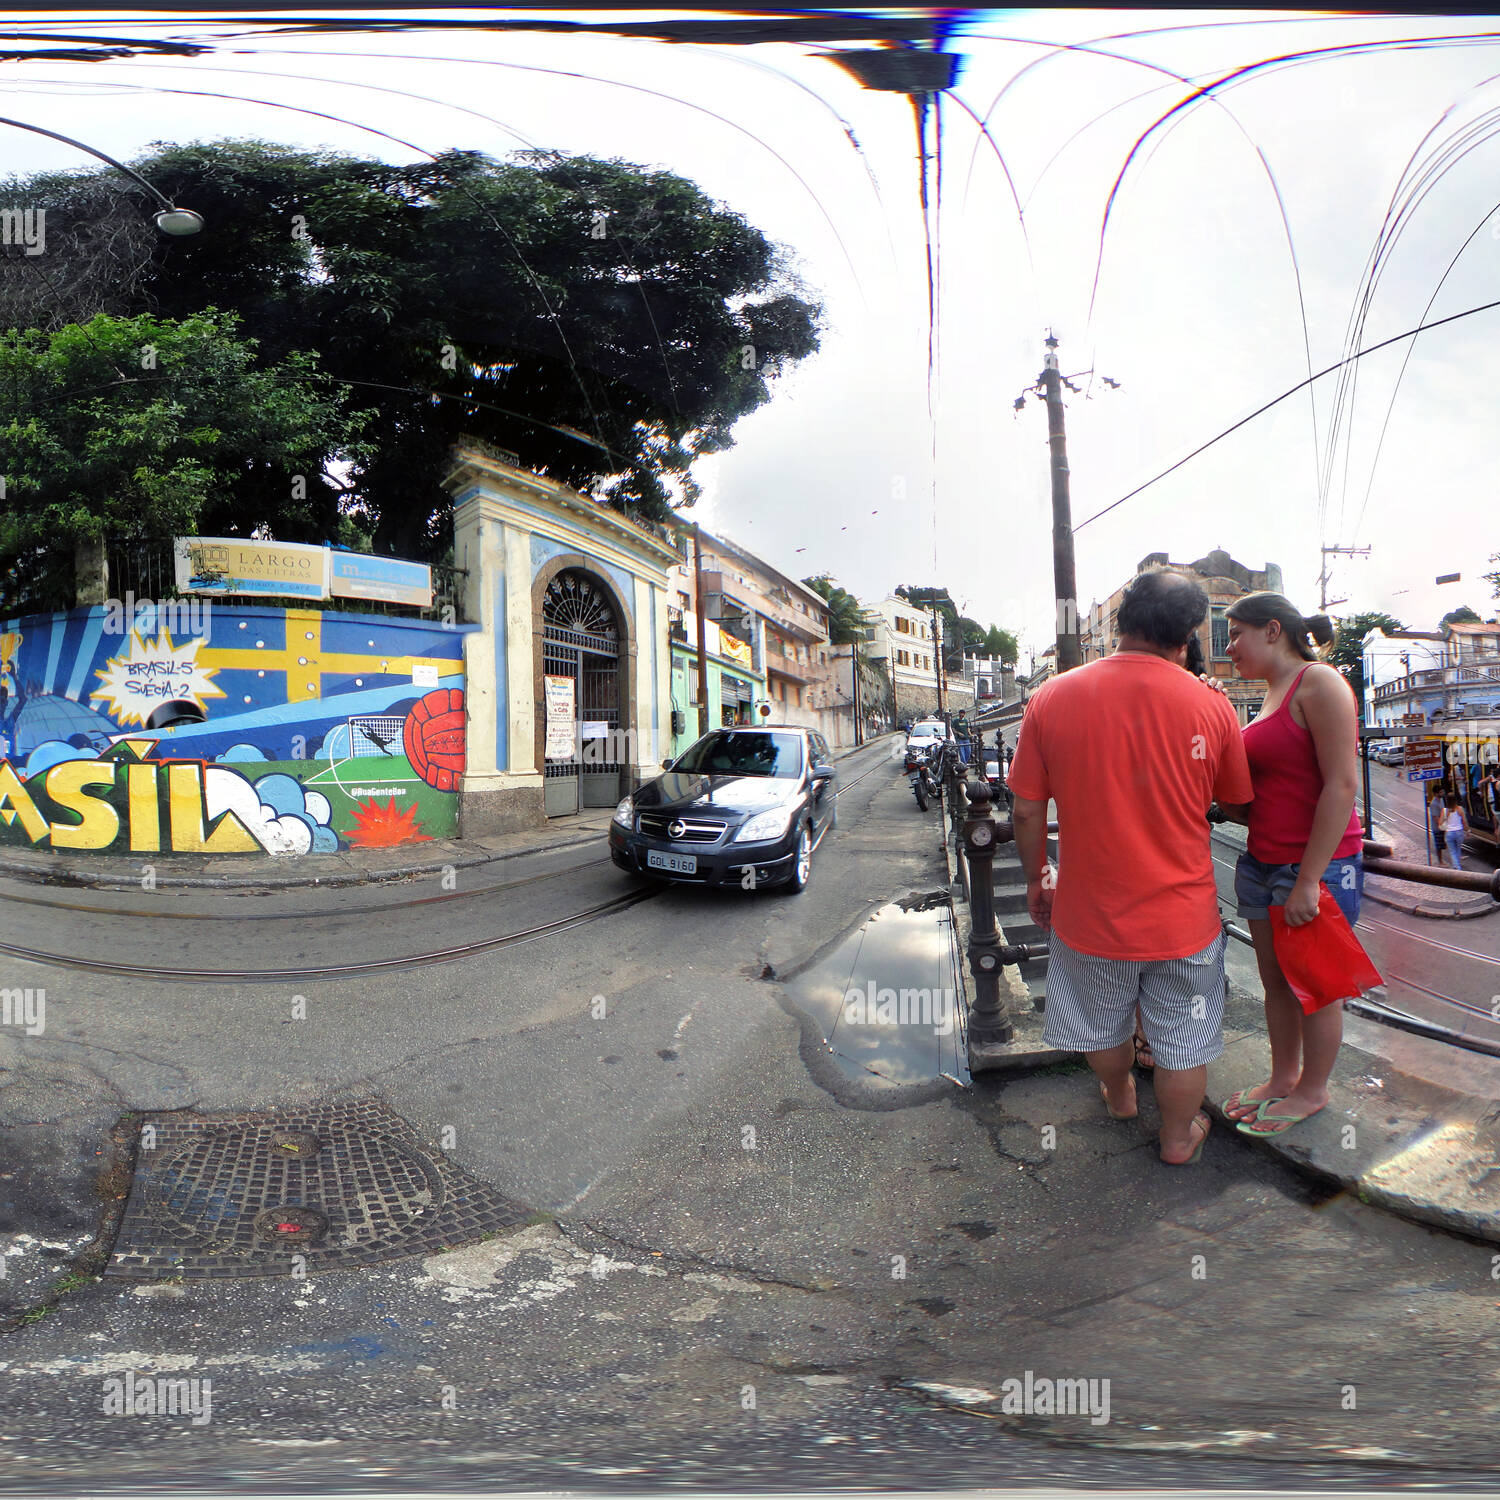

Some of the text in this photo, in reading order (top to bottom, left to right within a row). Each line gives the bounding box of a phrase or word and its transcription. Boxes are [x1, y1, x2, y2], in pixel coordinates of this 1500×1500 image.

[239, 552, 312, 571] LARGO
[239, 566, 312, 579] DAS LETRAS
